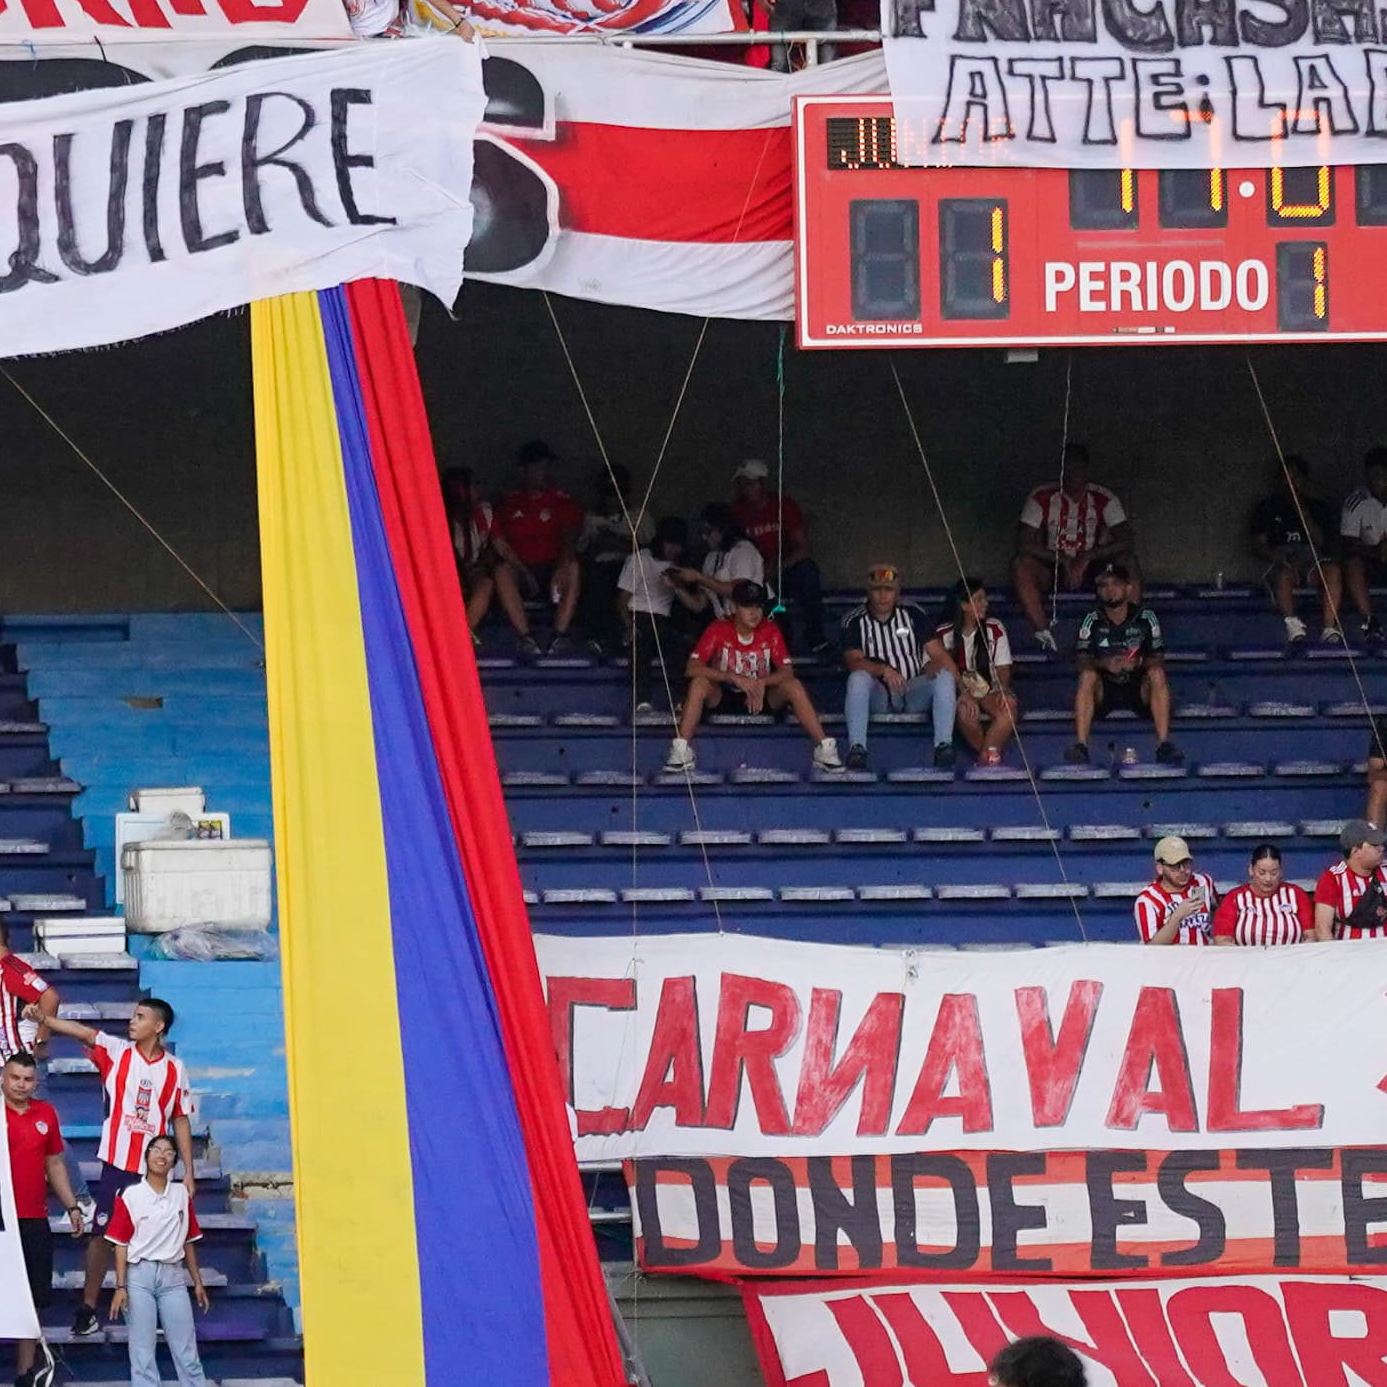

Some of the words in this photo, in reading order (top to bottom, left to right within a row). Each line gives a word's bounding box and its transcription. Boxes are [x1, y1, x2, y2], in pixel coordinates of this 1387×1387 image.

[1045, 259, 1270, 315] PERIODO
[826, 323, 923, 335] DAKTRONICS
[636, 1151, 1053, 1271] DONDE
[1087, 1148, 1387, 1270] ESTE
